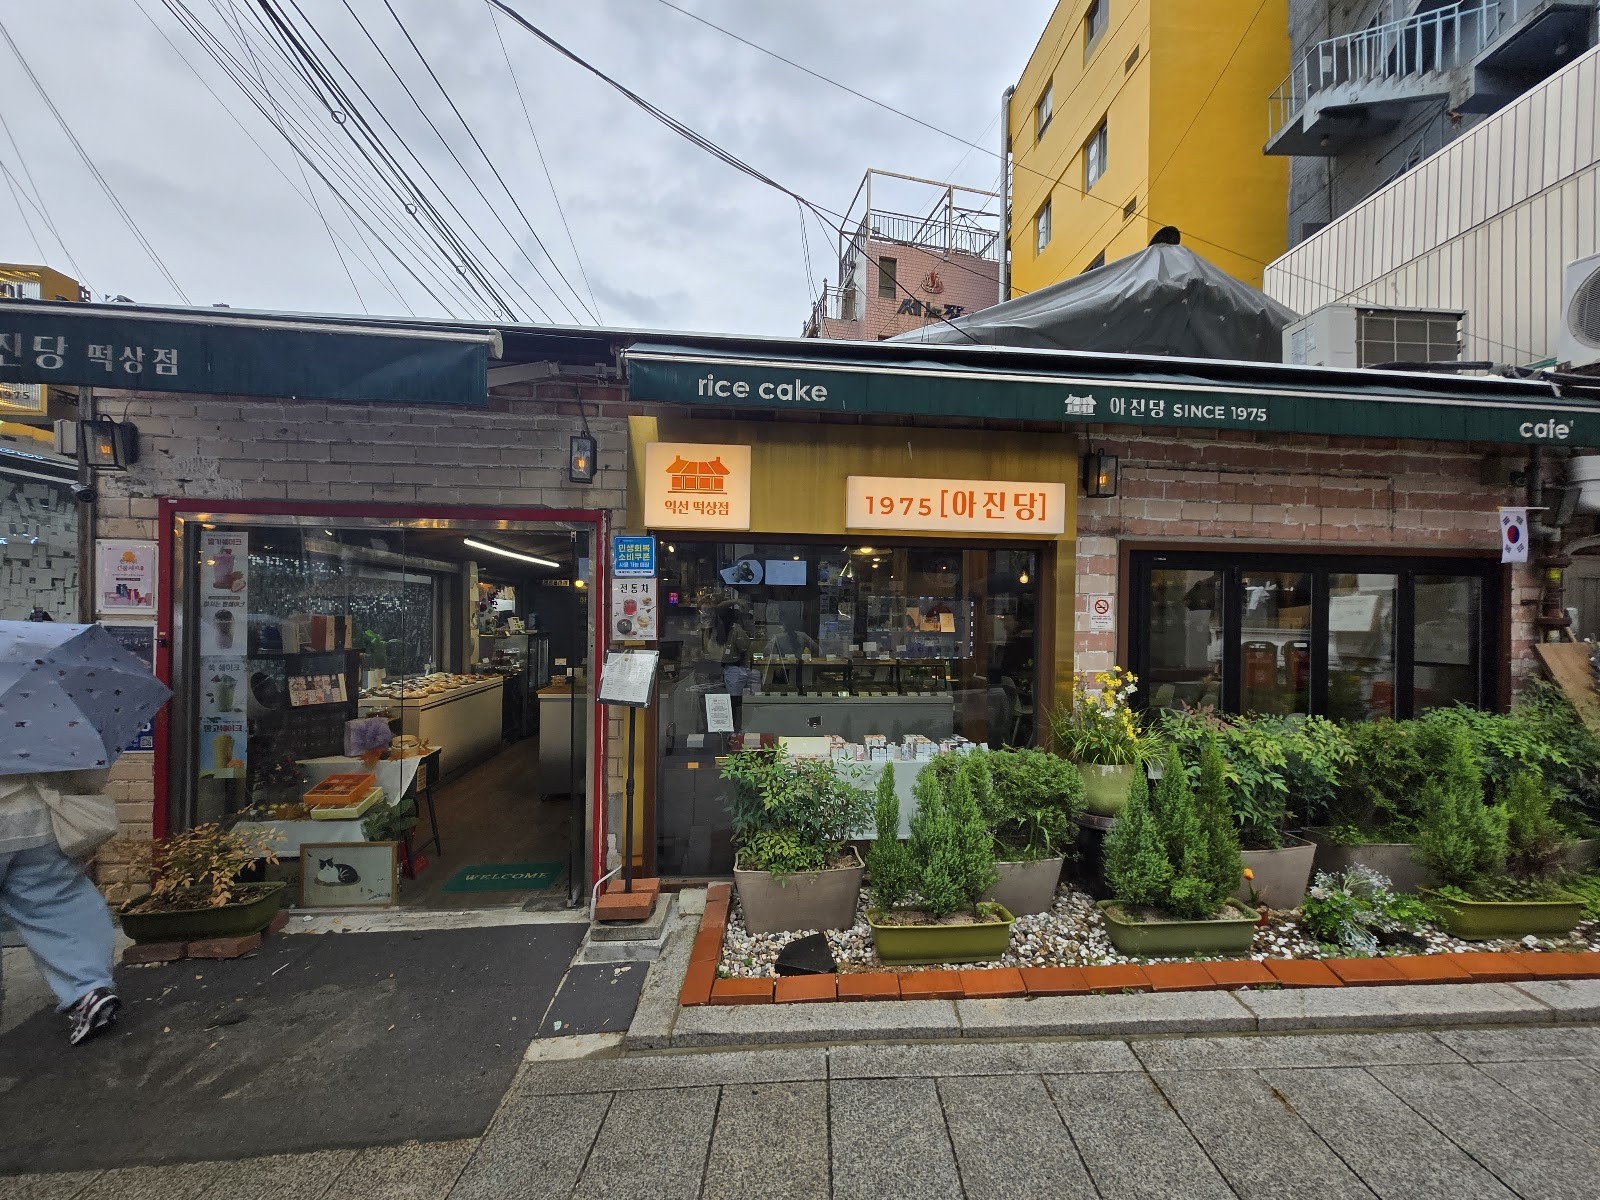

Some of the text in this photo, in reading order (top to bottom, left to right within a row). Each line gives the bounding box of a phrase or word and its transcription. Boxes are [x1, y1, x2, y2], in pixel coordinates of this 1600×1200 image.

[87, 344, 179, 376] 떡상점
[698, 373, 828, 402] rice cake
[1109, 397, 1267, 422] 아진당 SINCE 1975
[664, 500, 729, 516] 익선 떡상점
[865, 495, 932, 516] 1975
[618, 553, 651, 561] 소비쿠폰
[465, 872, 549, 881] WELCOME
